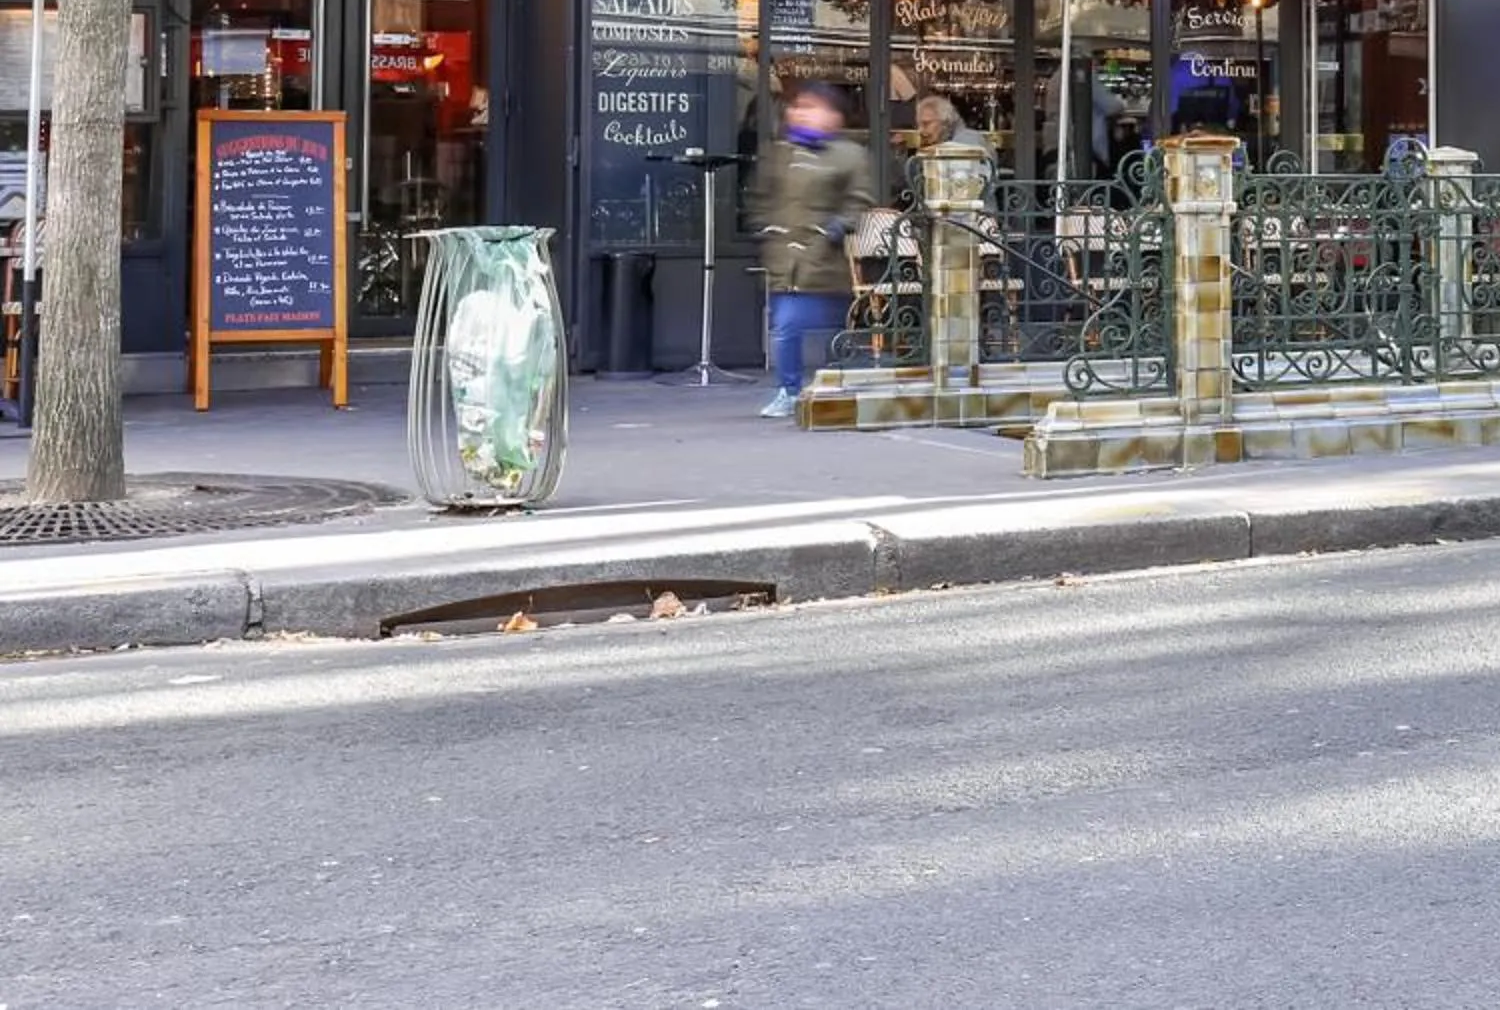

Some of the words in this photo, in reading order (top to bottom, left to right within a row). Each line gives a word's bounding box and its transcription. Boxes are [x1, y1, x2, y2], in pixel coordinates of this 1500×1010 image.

[592, 21, 690, 43] COMPOSÉES
[597, 48, 688, 87] Liqueurs
[912, 44, 995, 73] Formules
[1189, 53, 1258, 79] Continu
[598, 91, 690, 114] DIGESTIFS
[603, 118, 688, 146] Cocktails
